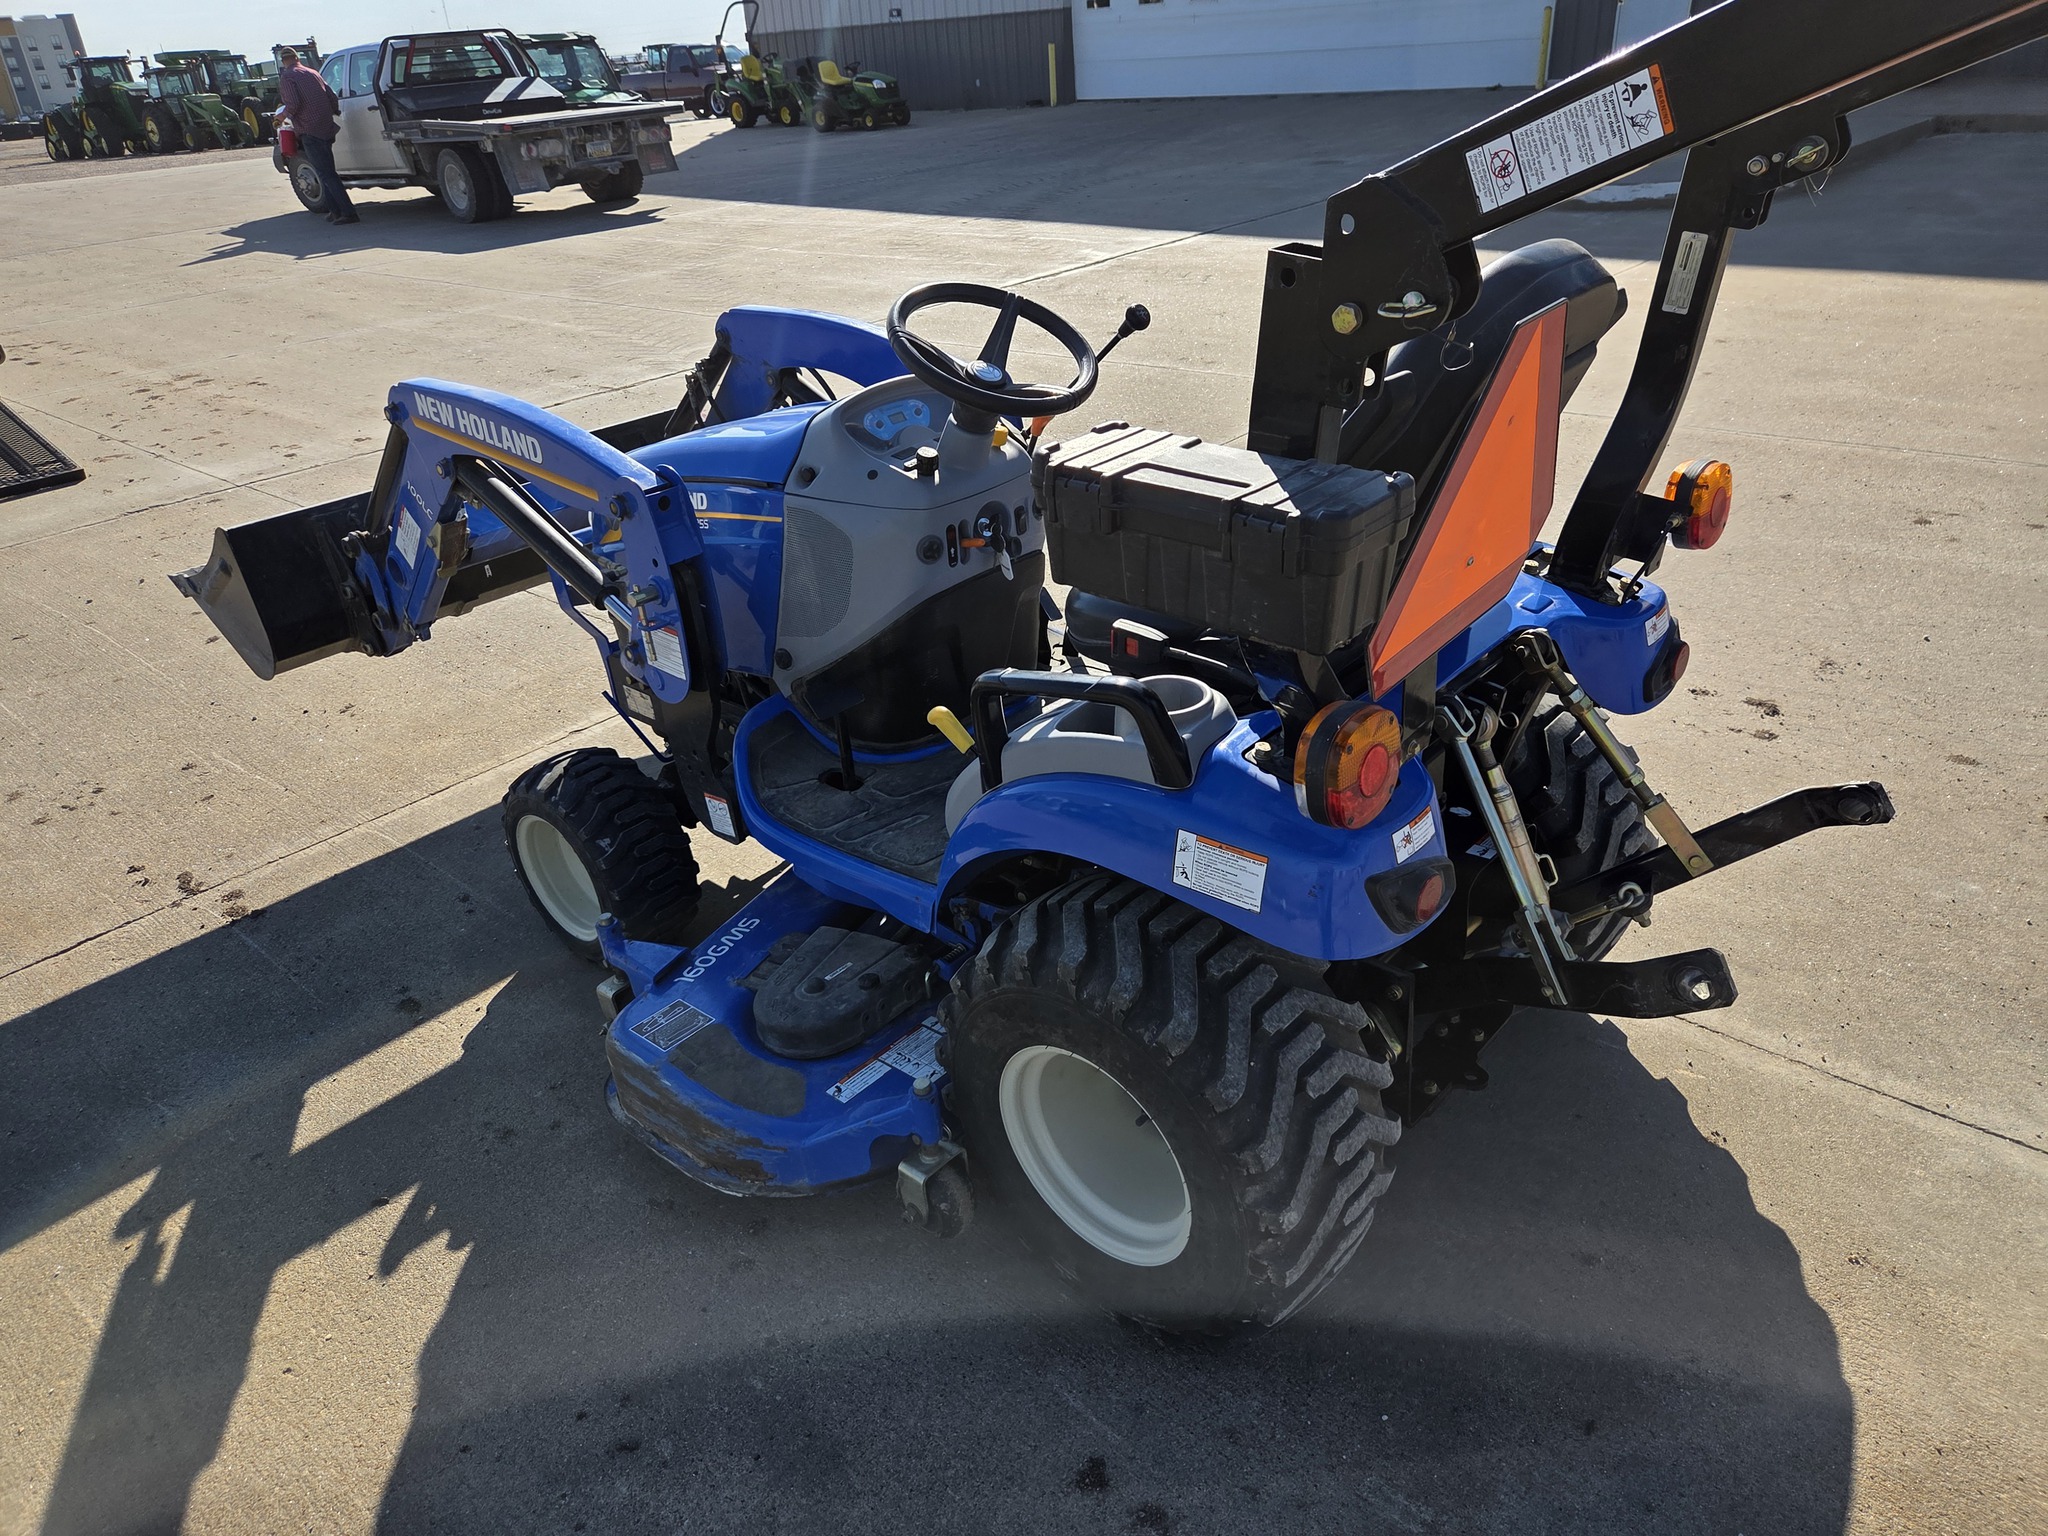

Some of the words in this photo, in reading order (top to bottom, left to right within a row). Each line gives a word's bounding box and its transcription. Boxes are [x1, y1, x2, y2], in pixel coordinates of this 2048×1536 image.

[1607, 90, 1614, 98] To
[1655, 87, 1670, 125] WARNING
[1556, 113, 1562, 122] Do
[1577, 103, 1586, 123] Always
[1582, 123, 1590, 140] fasten
[1606, 112, 1611, 120] or
[1608, 98, 1620, 124] prevent
[1576, 121, 1586, 147] operating
[1583, 147, 1591, 165] tractor
[1597, 112, 1607, 135] operate
[1604, 139, 1612, 157] tractor
[1608, 120, 1617, 139] death
[1616, 124, 1626, 148] serious
[1575, 143, 1585, 163] upright
[413, 391, 455, 429] NEW
[455, 407, 543, 464] HOLLAND
[407, 481, 434, 521] 100LC
[673, 917, 761, 983] 160GMS
